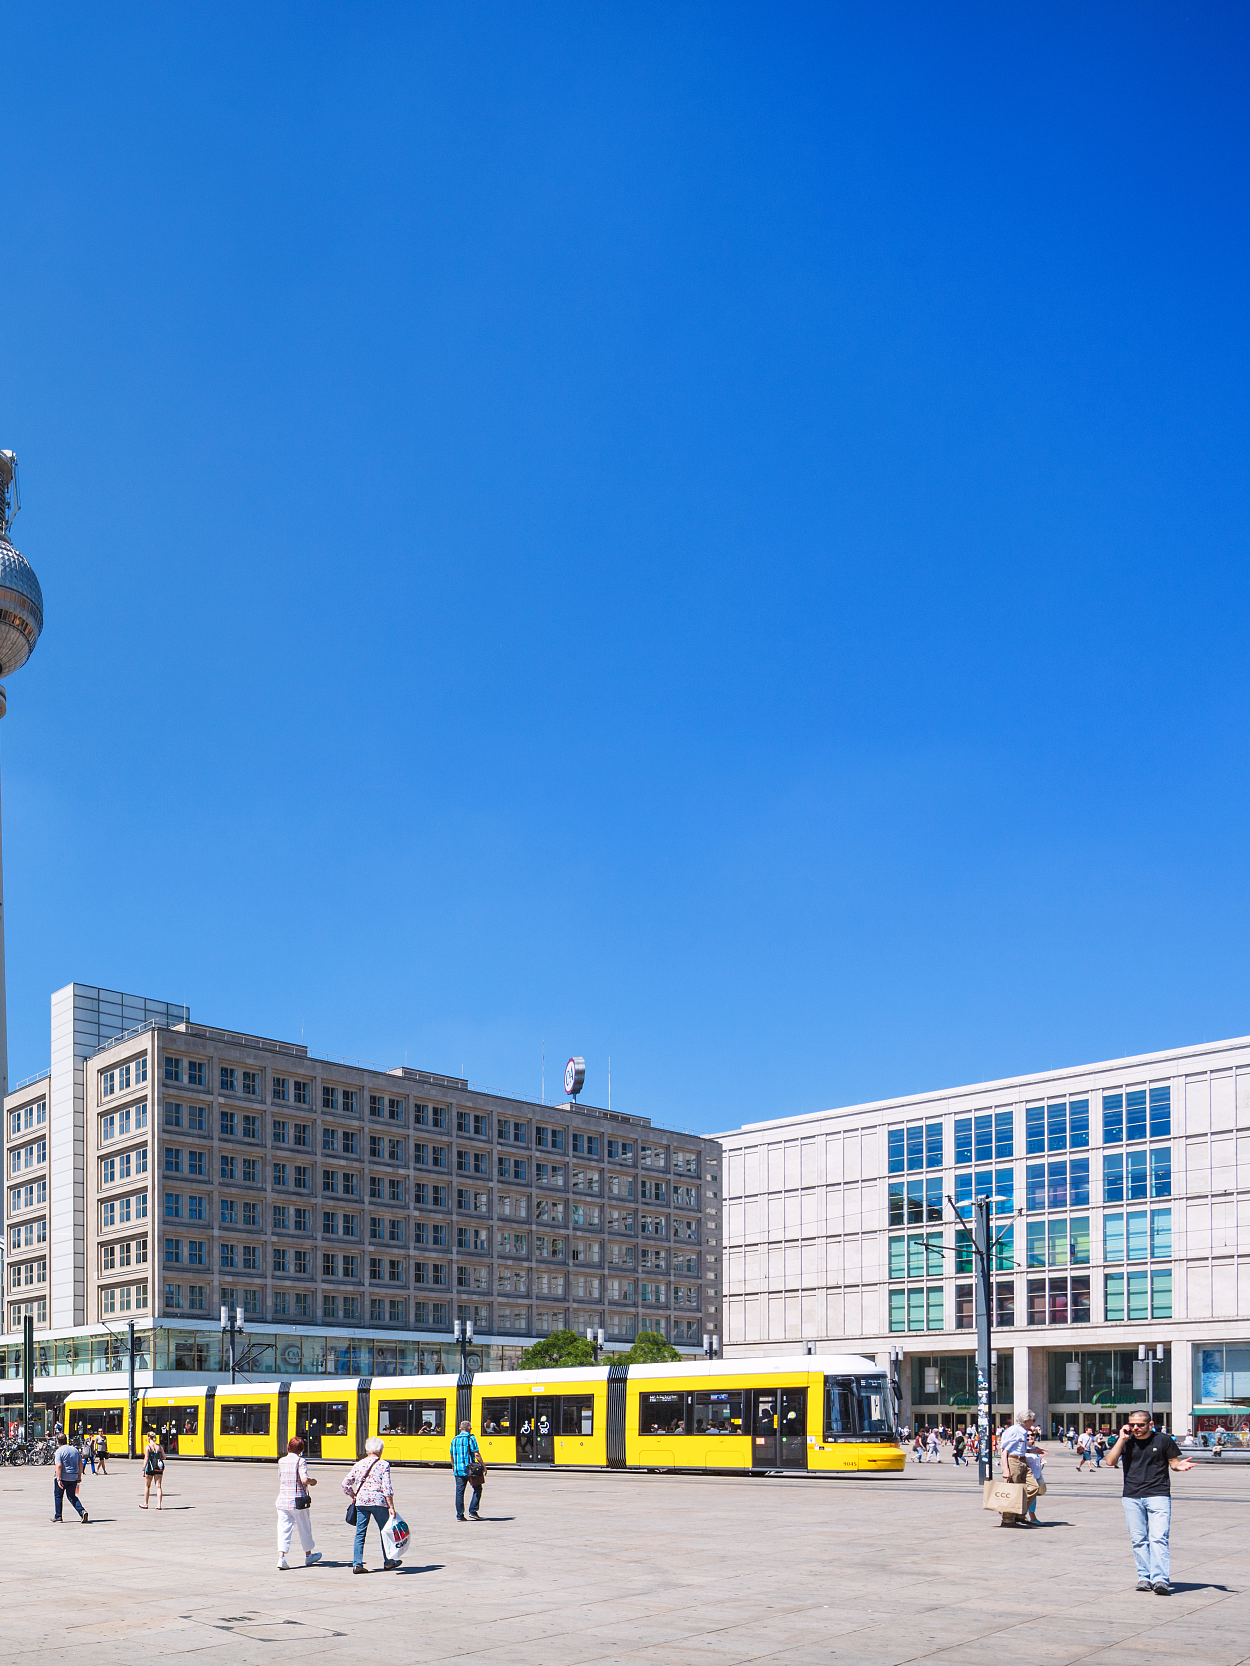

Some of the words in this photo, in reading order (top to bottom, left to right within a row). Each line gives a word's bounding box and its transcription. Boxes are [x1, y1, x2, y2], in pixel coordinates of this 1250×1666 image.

[1099, 1396, 1136, 1404] GALERIA
[1204, 1416, 1226, 1426] sale
[994, 1491, 1011, 1499] CCC
